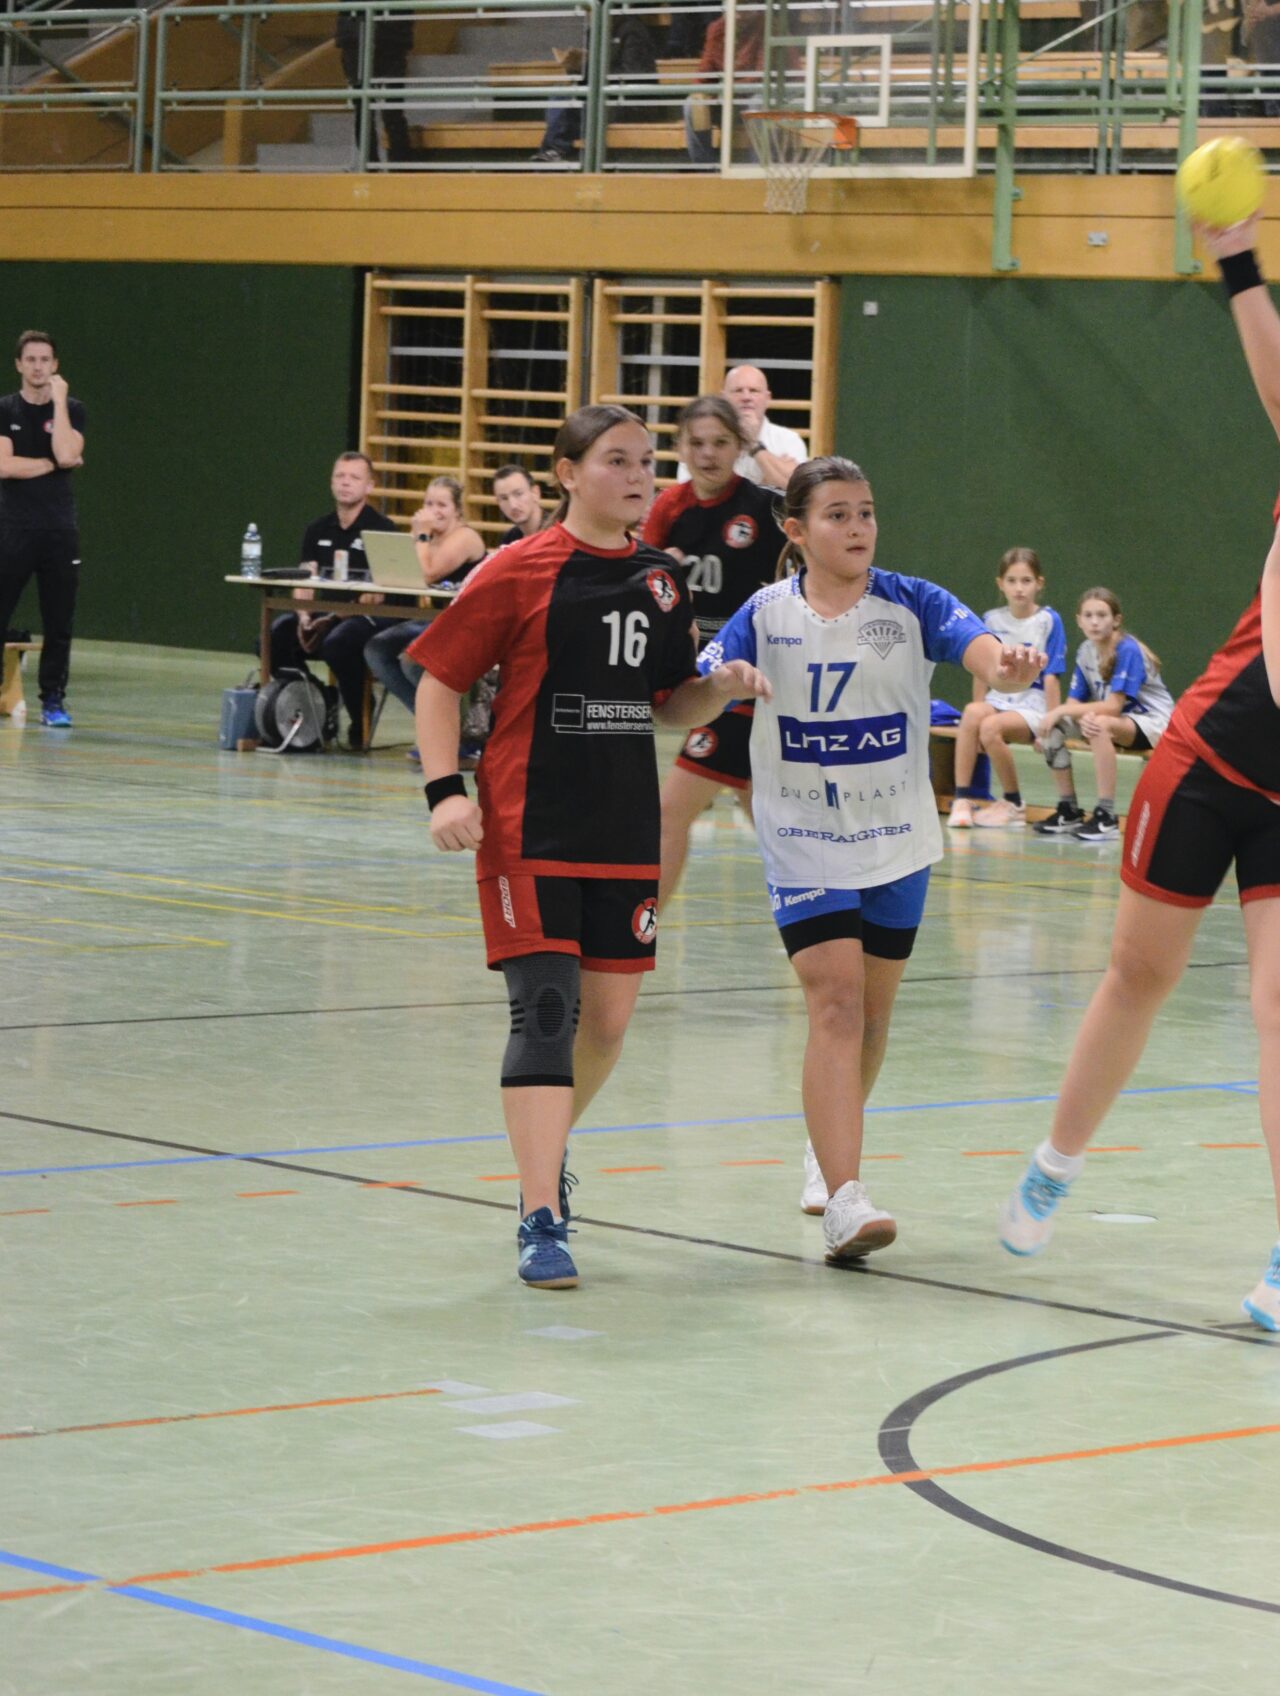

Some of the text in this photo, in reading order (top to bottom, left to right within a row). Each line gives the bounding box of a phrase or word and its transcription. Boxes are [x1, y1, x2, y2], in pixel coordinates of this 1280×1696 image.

[683, 554, 722, 594] 20
[602, 610, 650, 667] 16
[766, 634, 803, 648] Kempa
[806, 661, 858, 713] 17
[857, 727, 901, 751] AG
[843, 780, 907, 803] PLAST
[777, 823, 912, 843] OBERAIGNER
[784, 887, 826, 907] Kempa
